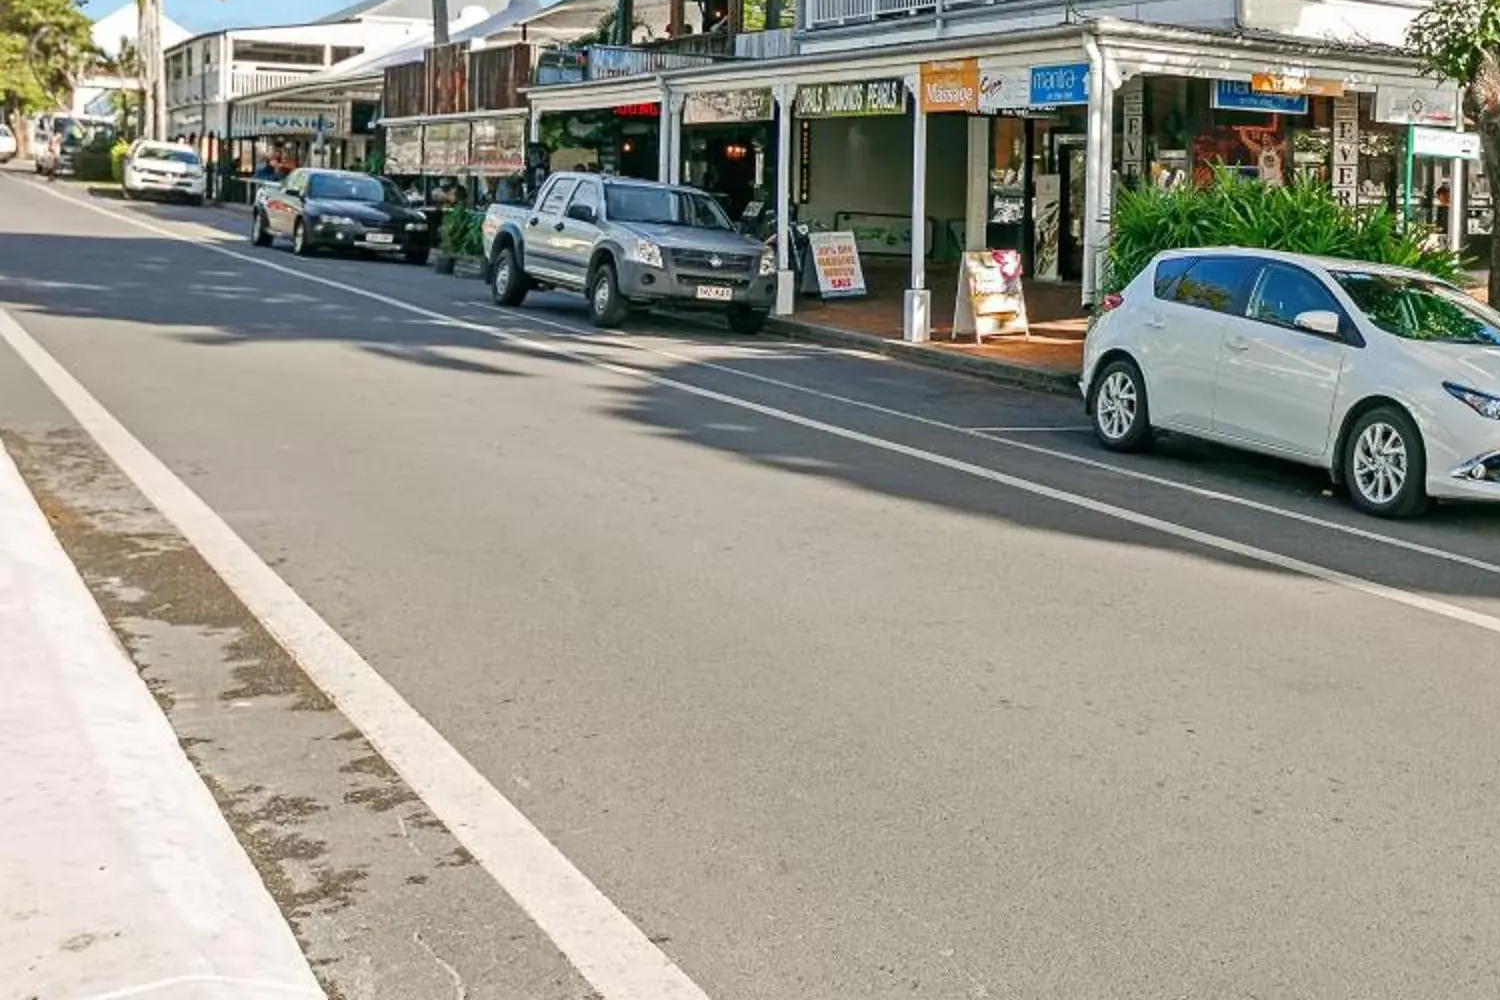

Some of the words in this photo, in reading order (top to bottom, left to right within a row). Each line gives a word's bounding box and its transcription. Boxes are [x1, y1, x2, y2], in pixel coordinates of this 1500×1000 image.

[1033, 70, 1076, 90] mantra
[866, 81, 897, 109] PEARLS
[927, 83, 973, 107] Massage
